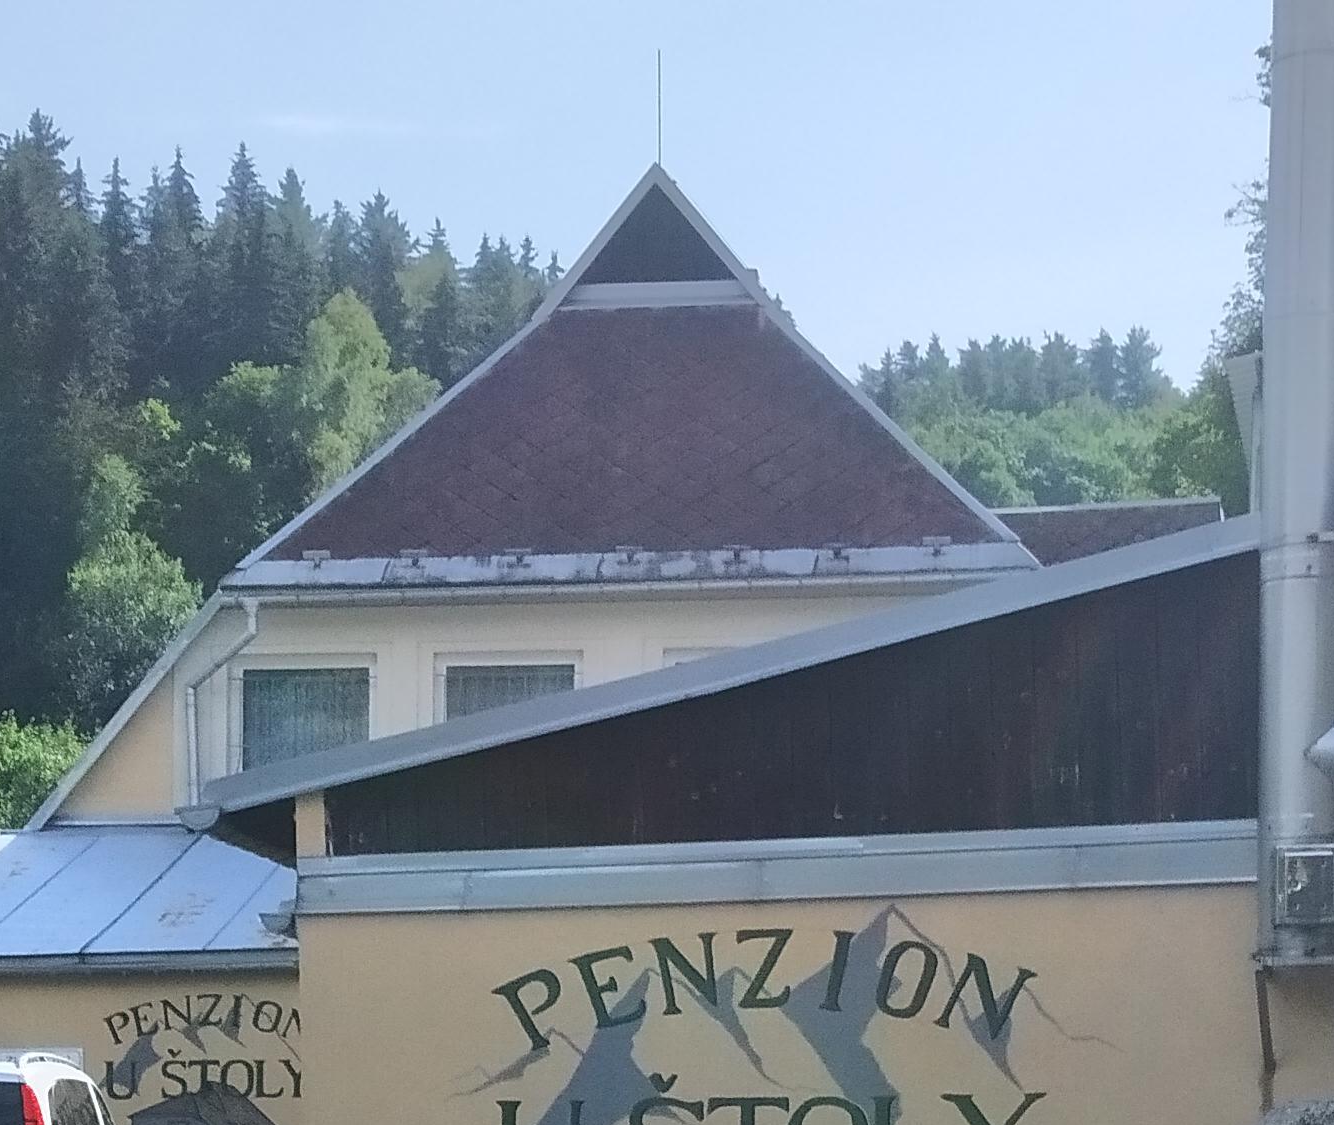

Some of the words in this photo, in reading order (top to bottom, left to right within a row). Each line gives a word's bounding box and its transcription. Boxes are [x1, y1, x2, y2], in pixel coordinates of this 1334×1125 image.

[492, 928, 1037, 1050] PENZION
[105, 1060, 138, 1100] U
[161, 1048, 302, 1099] ŠTOLY
